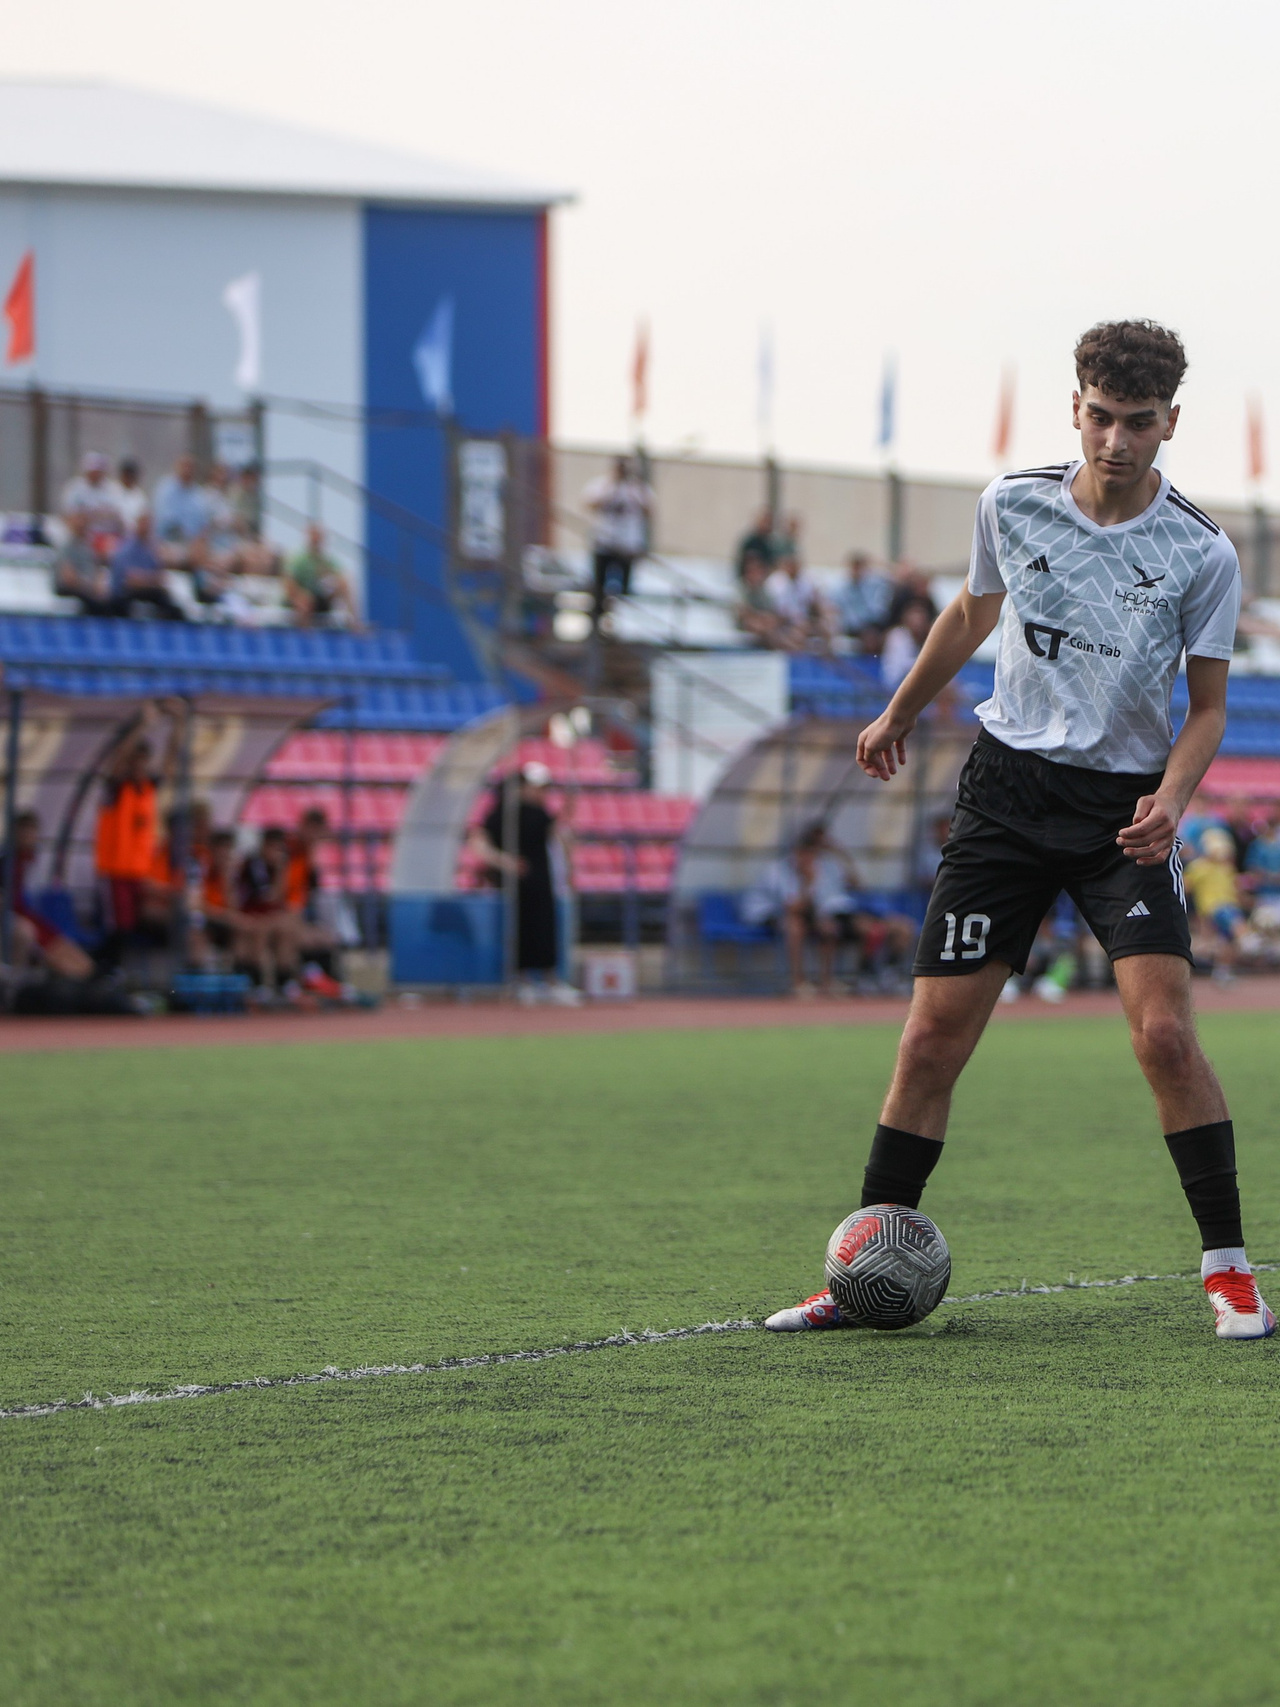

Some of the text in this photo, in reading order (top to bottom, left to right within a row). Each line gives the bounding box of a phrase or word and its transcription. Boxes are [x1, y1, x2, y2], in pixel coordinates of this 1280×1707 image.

[1115, 589, 1169, 612] ЧАЙКА
[1122, 605, 1156, 617] САМАРА
[1069, 637, 1121, 658] Coin Tab
[940, 912, 991, 961] 19
